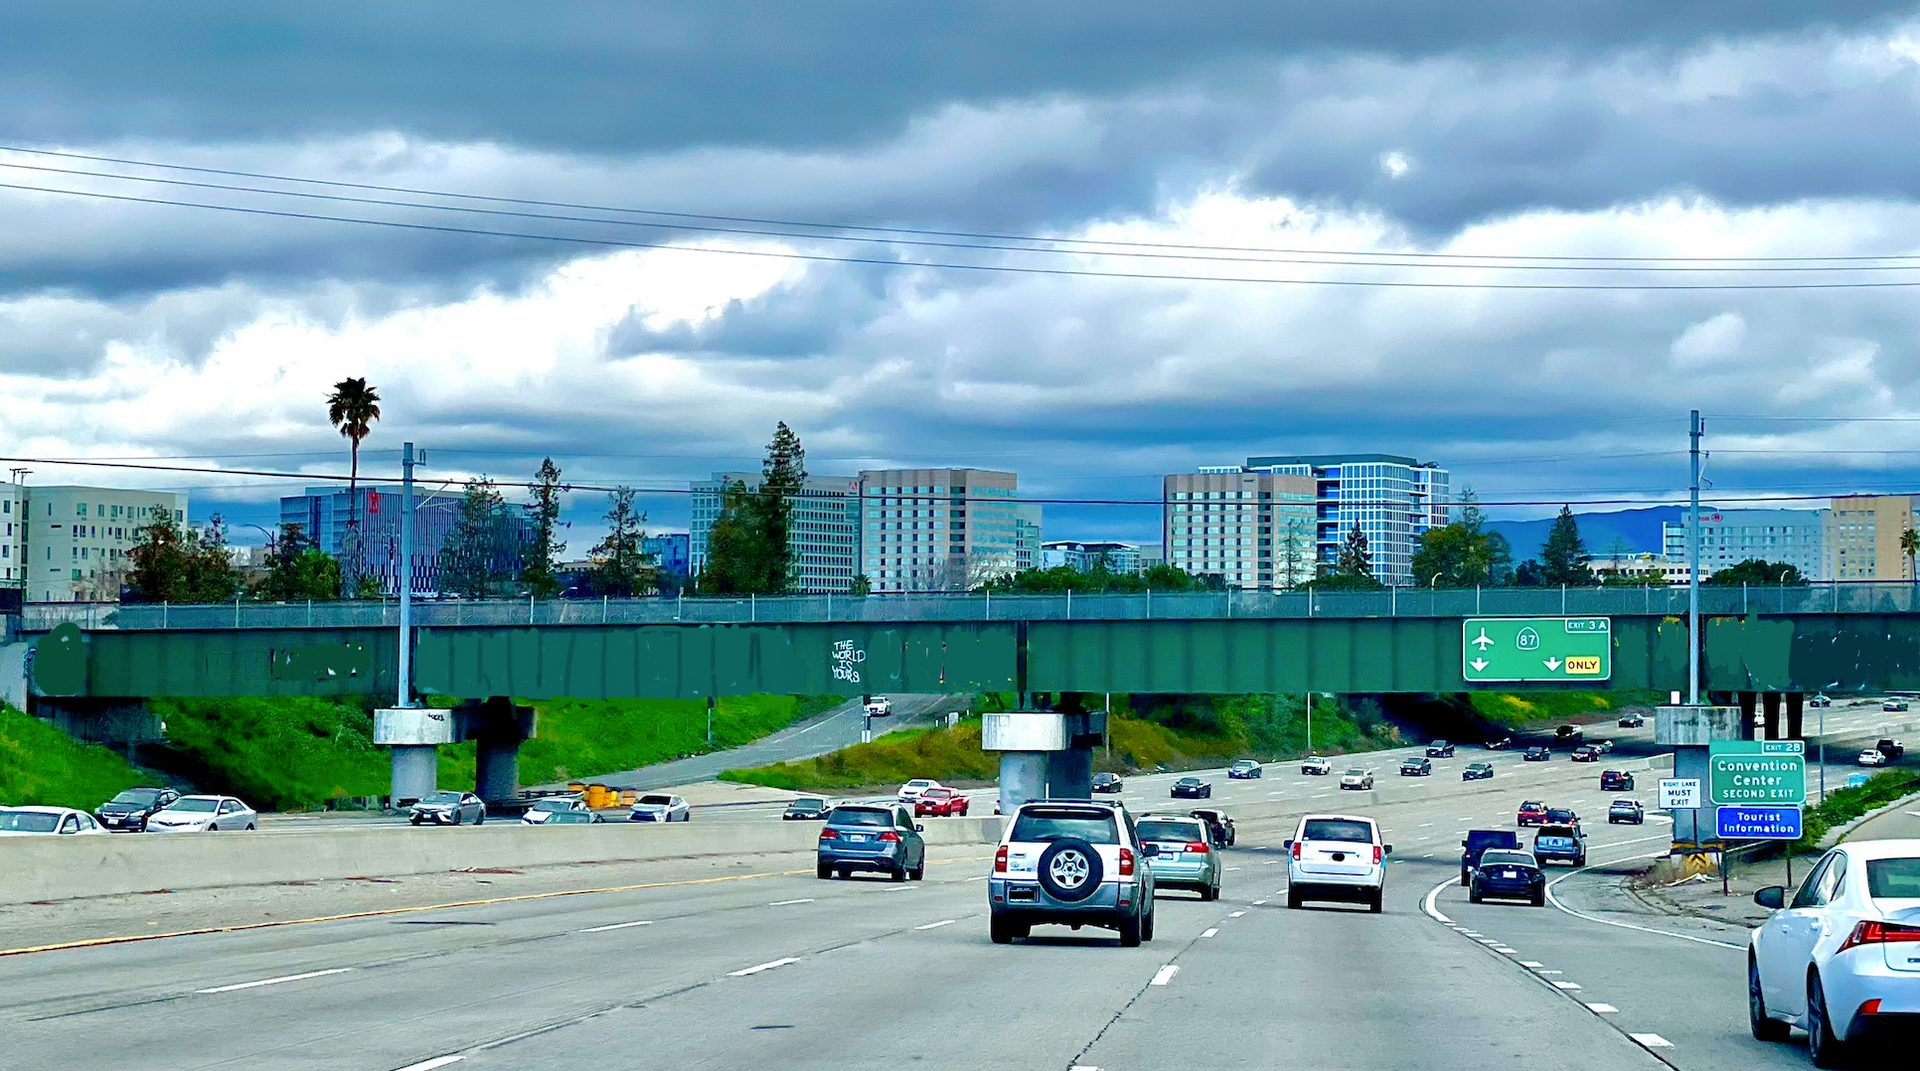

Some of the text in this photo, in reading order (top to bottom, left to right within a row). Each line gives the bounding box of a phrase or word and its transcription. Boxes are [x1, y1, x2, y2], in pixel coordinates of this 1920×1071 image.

[833, 639, 854, 651] THE
[1520, 635, 1536, 646] 87
[831, 649, 866, 663] WORLD
[839, 659, 853, 671] IS
[1568, 661, 1597, 670] ONLY
[1786, 743, 1801, 752] 2B
[1717, 760, 1798, 772] Convention
[1733, 774, 1782, 786] Center
[1667, 789, 1692, 797] MUST
[1722, 789, 1794, 798] SECOND EXIT
[1670, 798, 1690, 806] EXIT
[1737, 812, 1781, 822] Tourist
[1723, 823, 1795, 833] Information
